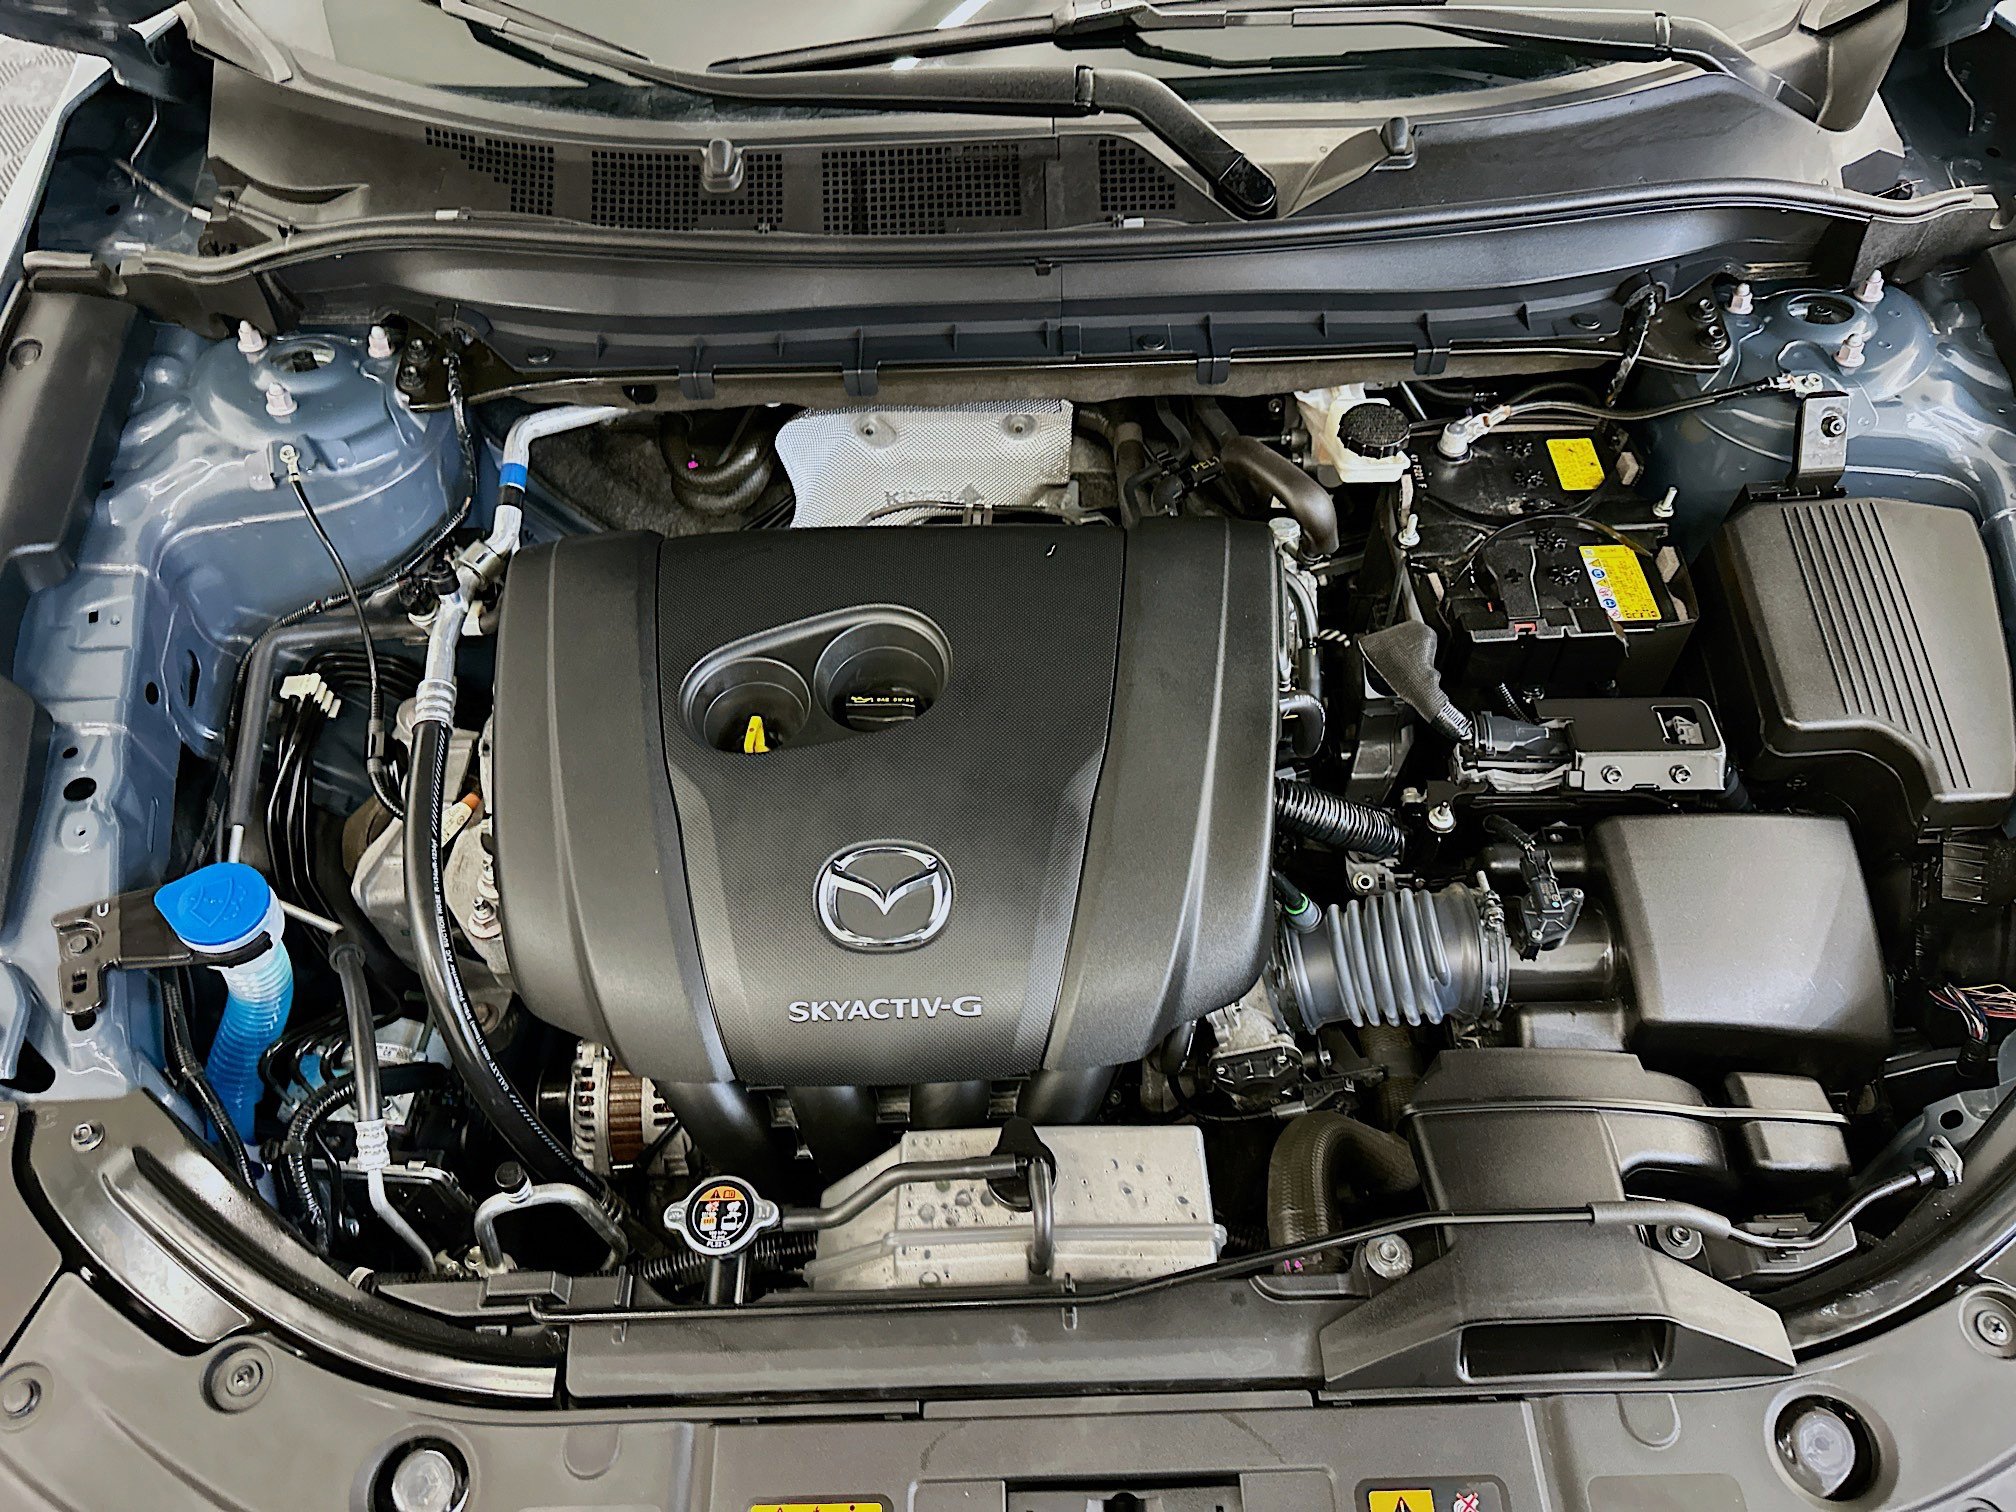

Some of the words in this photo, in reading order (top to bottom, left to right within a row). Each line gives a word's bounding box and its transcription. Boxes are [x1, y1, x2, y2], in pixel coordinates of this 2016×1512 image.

[438, 915, 450, 948] SUCTION
[788, 996, 982, 1022] SKYACTIV-G
[489, 1061, 510, 1092] GALAXY
